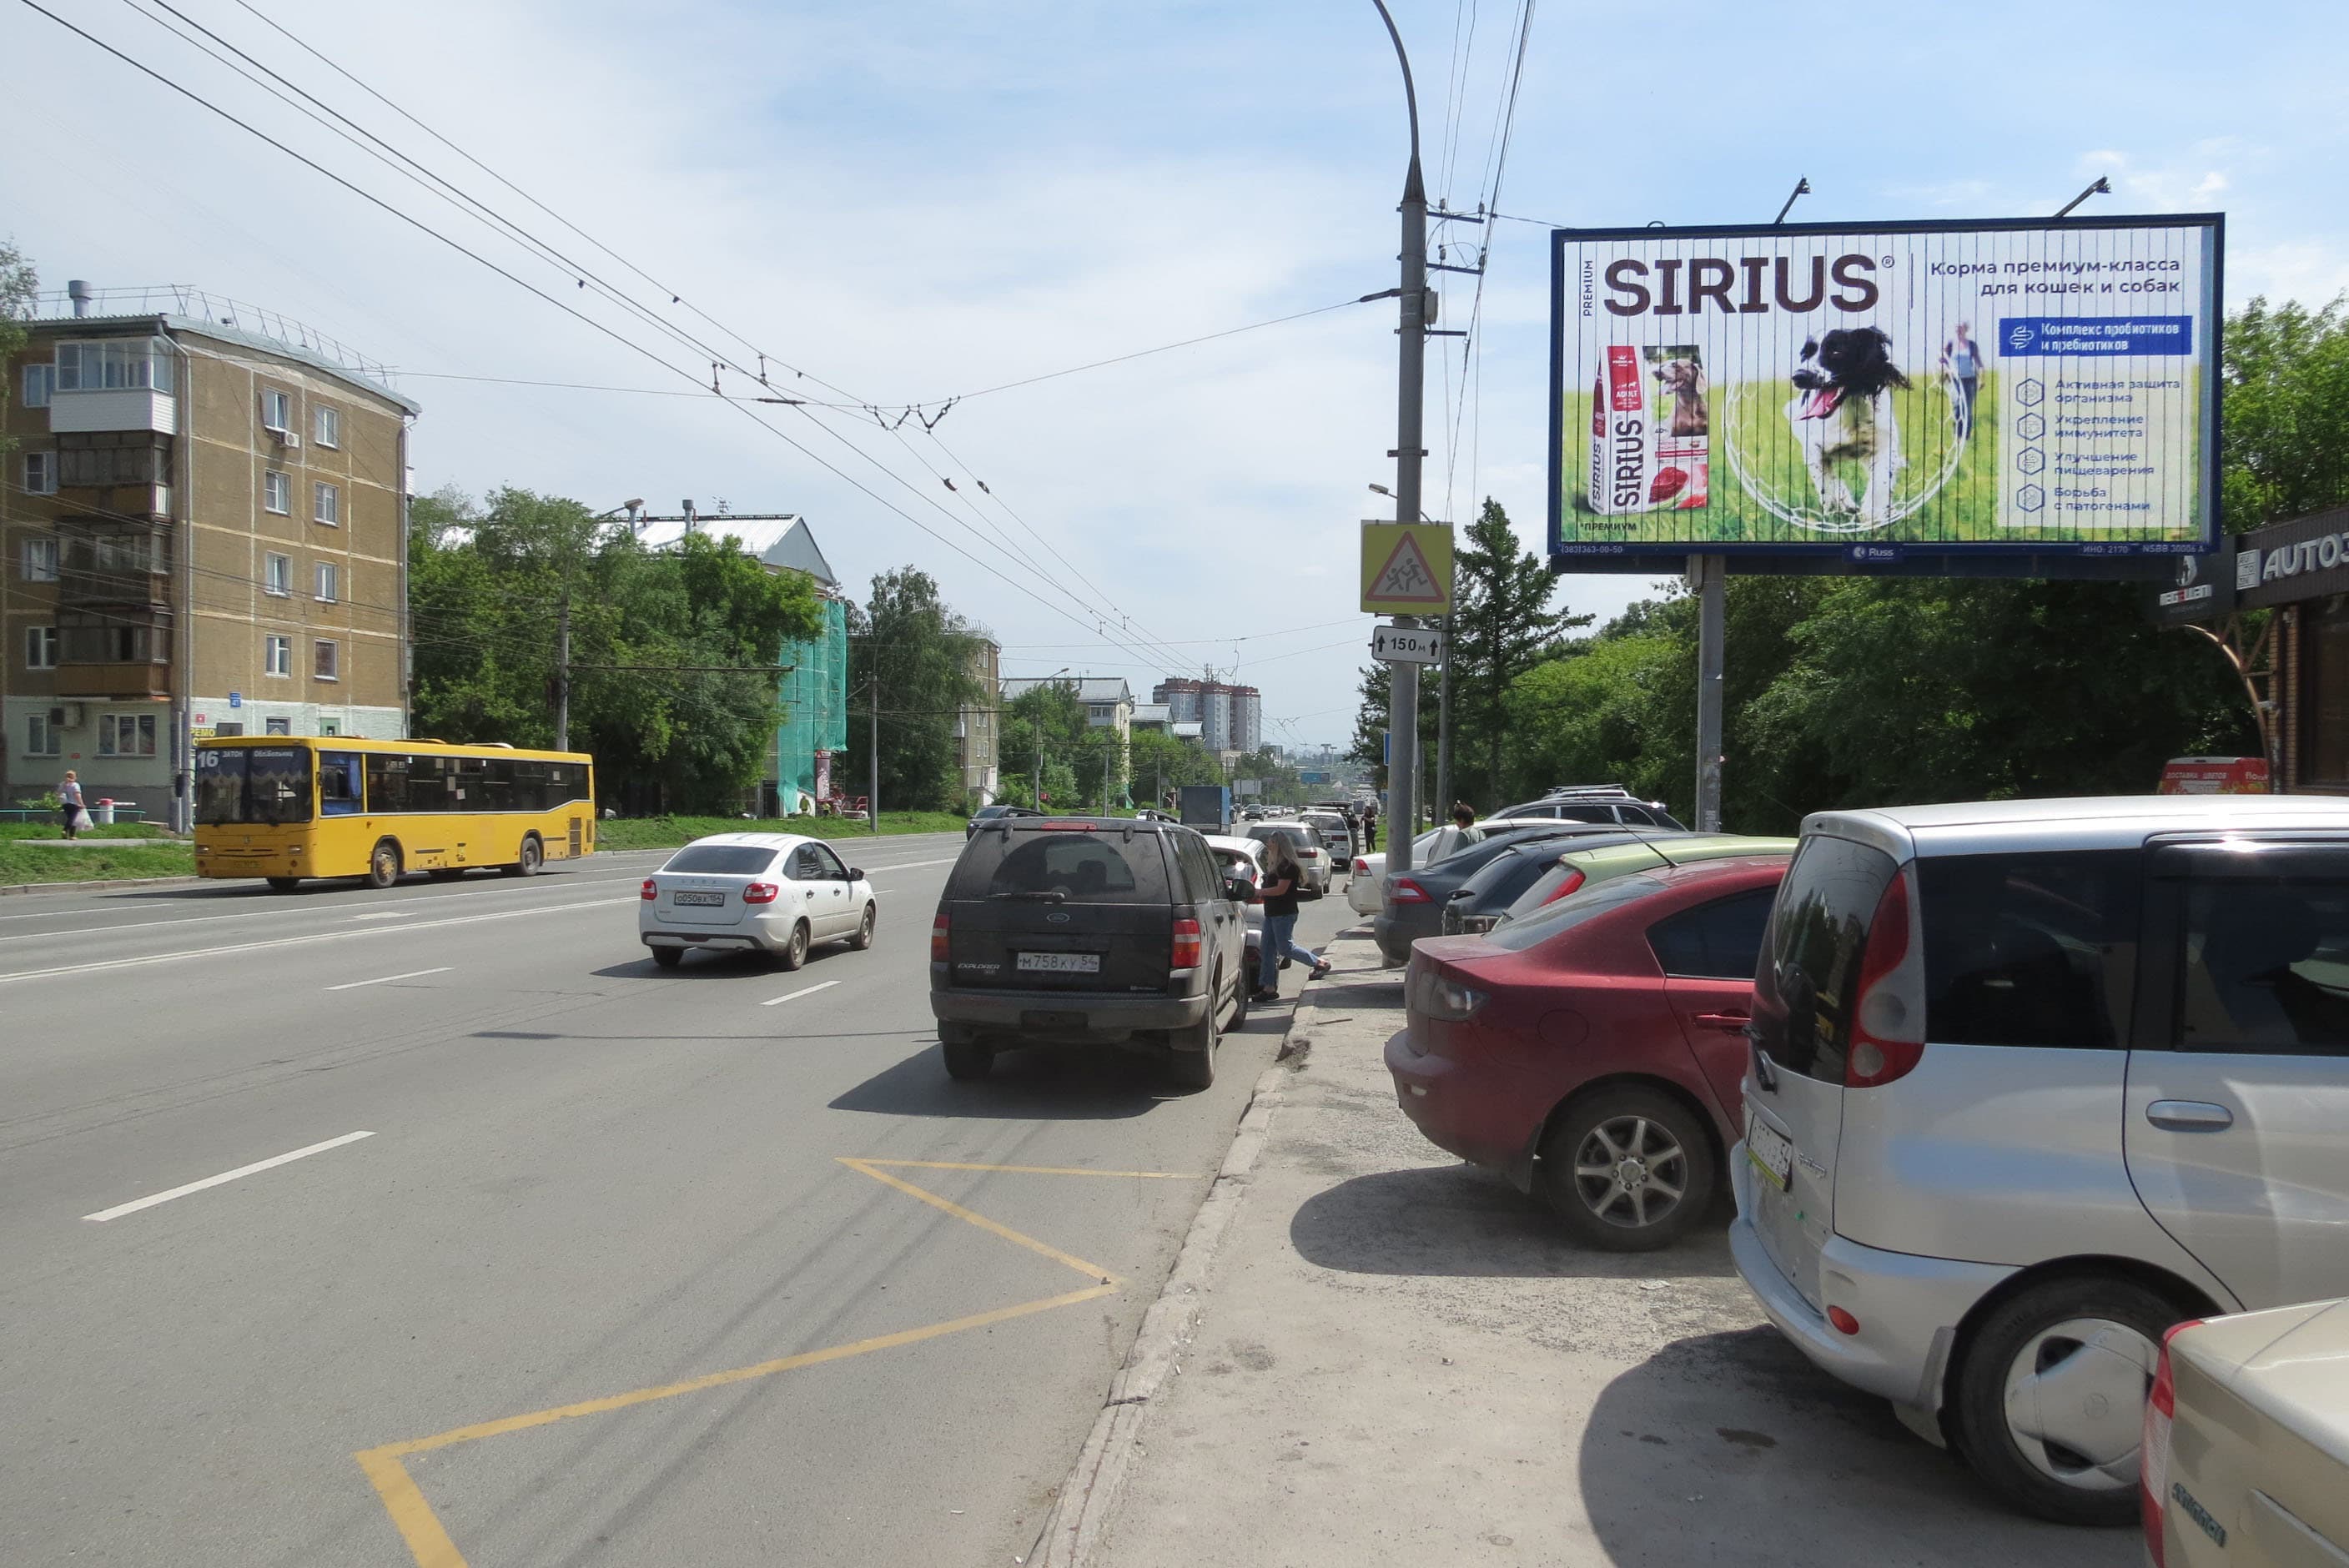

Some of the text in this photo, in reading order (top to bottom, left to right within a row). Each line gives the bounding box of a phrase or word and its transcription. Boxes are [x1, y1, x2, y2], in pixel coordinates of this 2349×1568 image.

[1930, 259, 2180, 277] Корма премиум-класса
[1582, 259, 1593, 316] PREMIUM
[1603, 254, 1879, 316] SIRIUS
[1981, 279, 2180, 297] для кошек и собак
[2041, 321, 2180, 336] Комплекс пробиотиков
[2041, 339, 2129, 354] и пребиотиков
[2055, 380, 2181, 390] Активная защита
[2055, 395, 2133, 405] организма
[2055, 415, 2144, 426] Укрепление
[2055, 430, 2143, 440] иммунитета
[1613, 420, 1643, 507] SIRIUS
[2055, 453, 2138, 464] Улучшение
[1592, 443, 1602, 501] SIRIUS
[2055, 466, 2155, 477] пищеварения
[2055, 487, 2107, 499] Борьба
[2055, 501, 2150, 511] с патогенами
[1869, 547, 1894, 557] Russ
[1391, 637, 1416, 651] 150
[197, 750, 219, 768] 16
